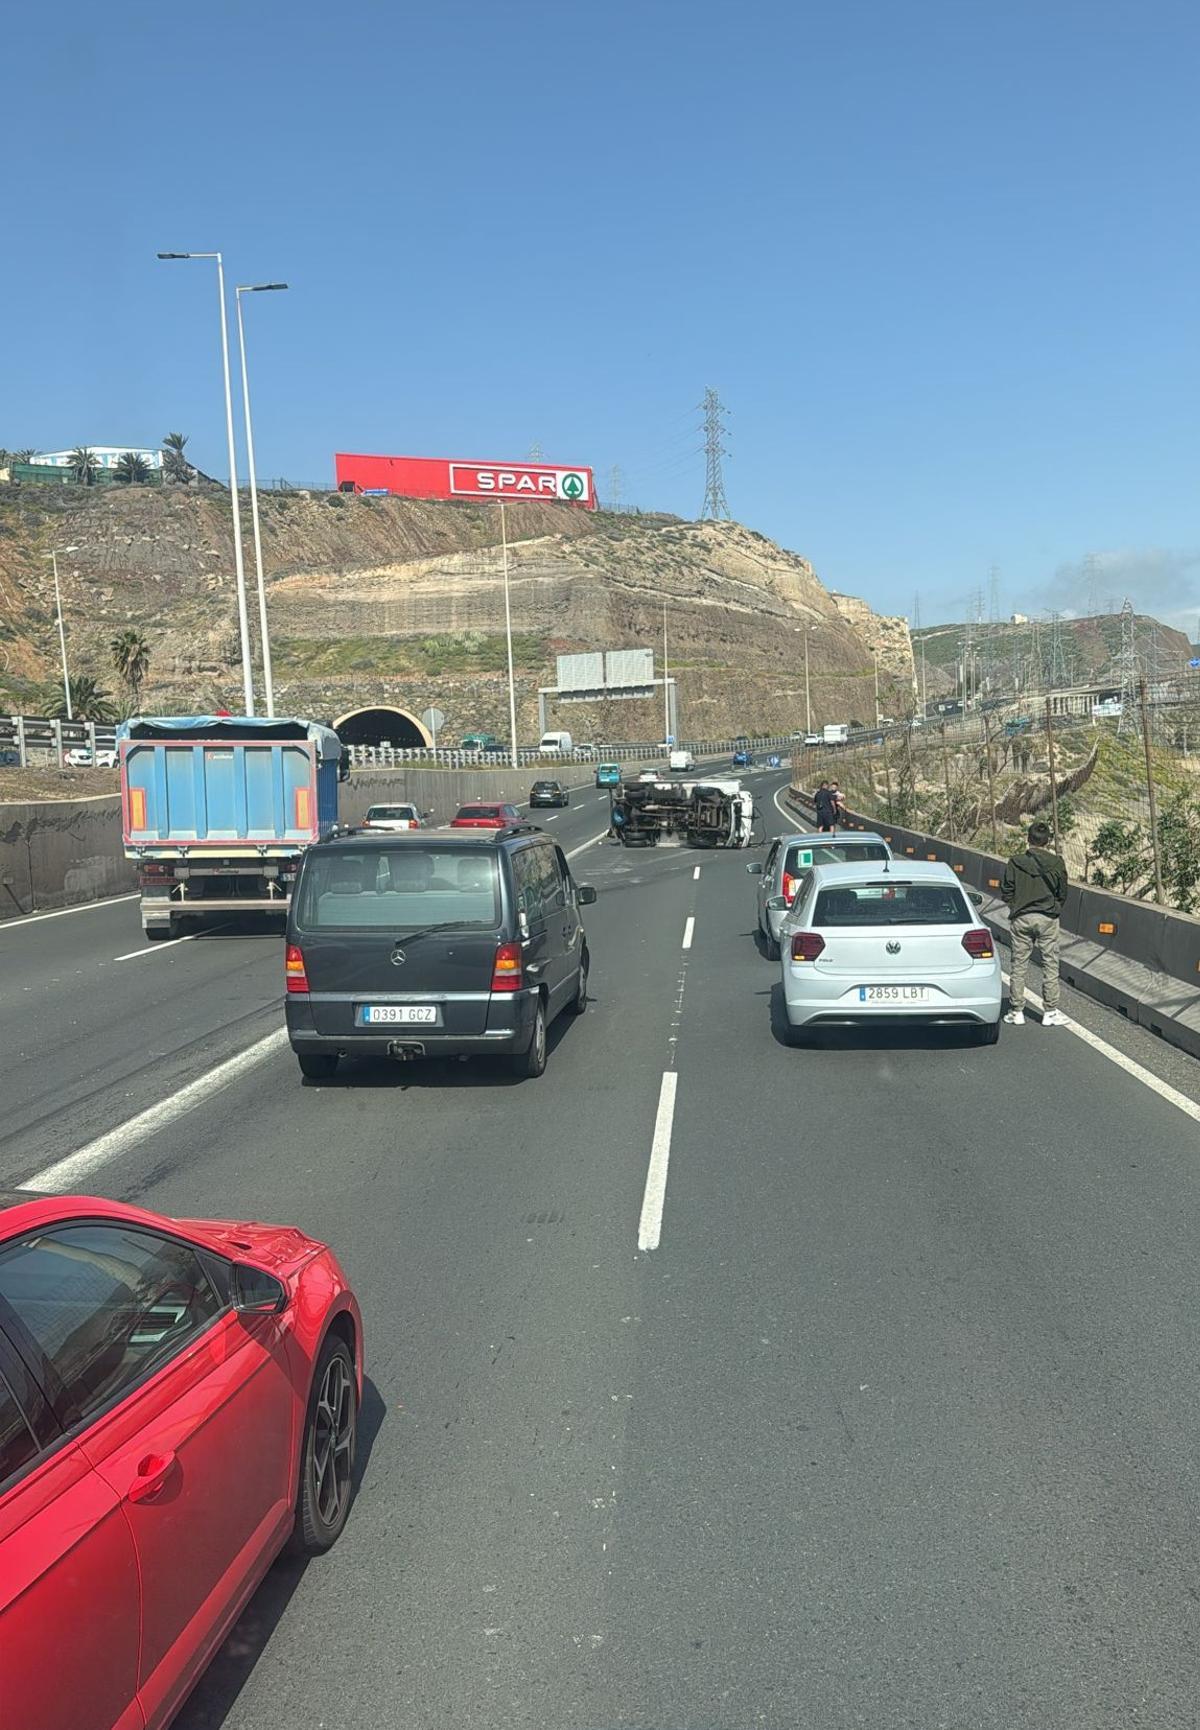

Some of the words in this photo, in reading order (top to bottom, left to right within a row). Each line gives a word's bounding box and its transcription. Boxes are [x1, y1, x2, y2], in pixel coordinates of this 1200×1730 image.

[476, 472, 556, 492] SPAR
[868, 987, 899, 999] 2859
[902, 987, 925, 999] LBT
[373, 1008, 403, 1021] 0391
[408, 1008, 432, 1021] GCZ
